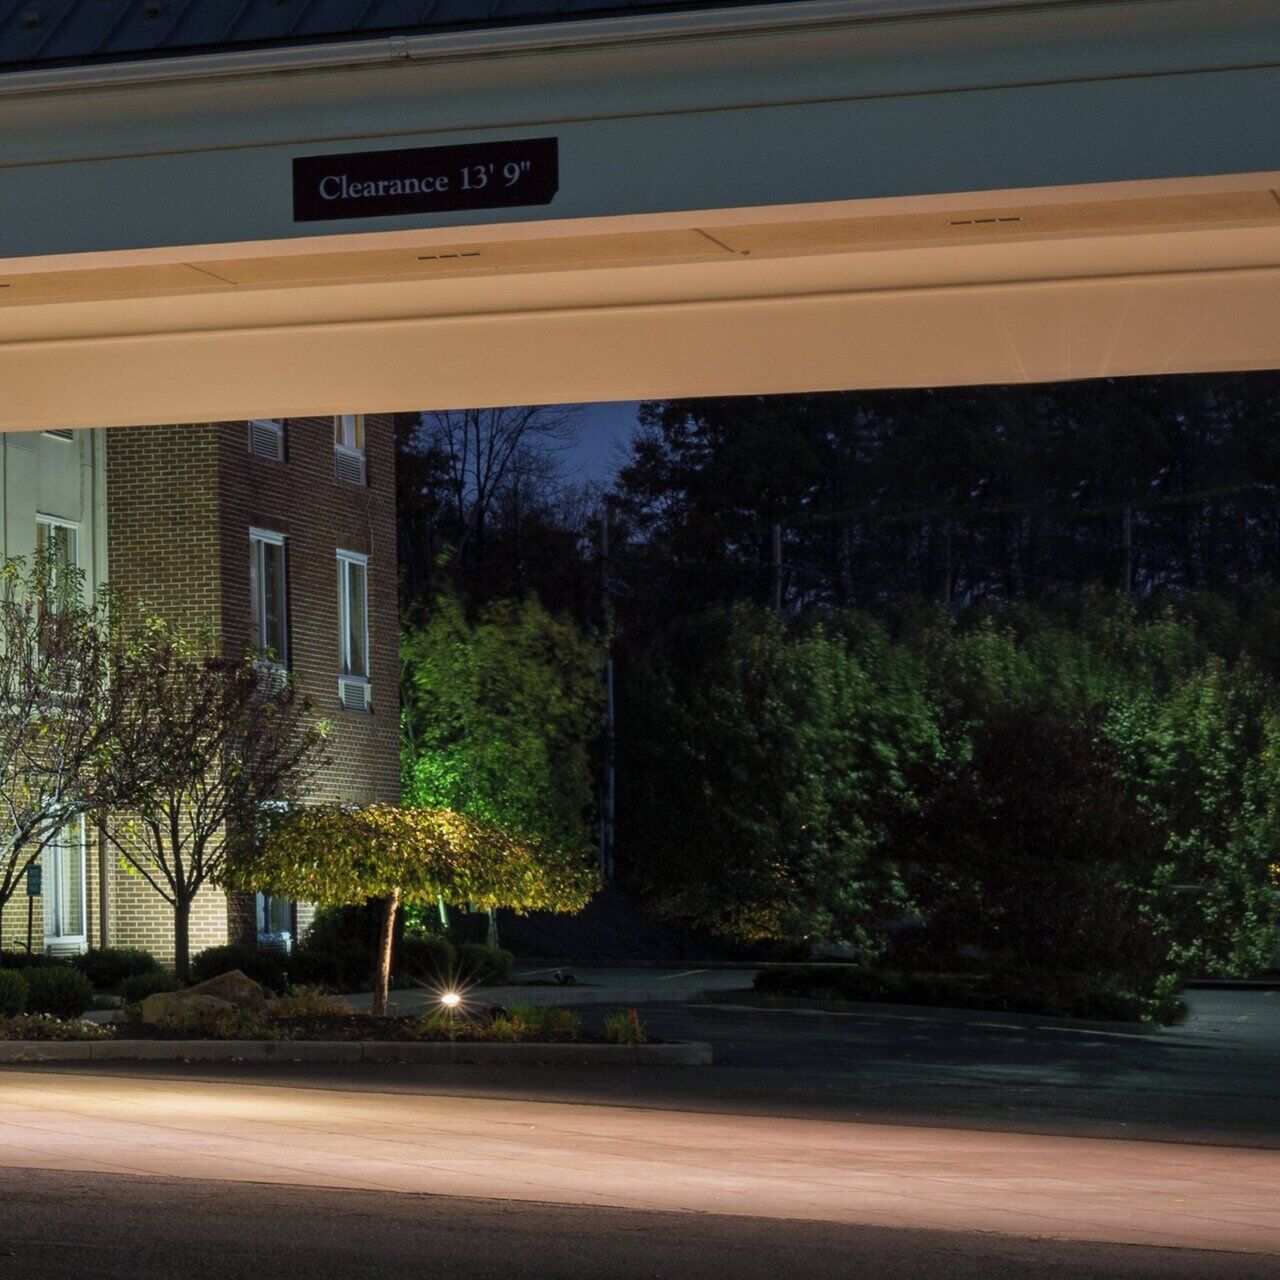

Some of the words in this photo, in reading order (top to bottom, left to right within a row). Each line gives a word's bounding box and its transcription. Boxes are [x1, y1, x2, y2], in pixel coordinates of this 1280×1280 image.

[318, 175, 449, 201] Clearance
[460, 164, 494, 191] 13'
[502, 160, 532, 188] 9"
